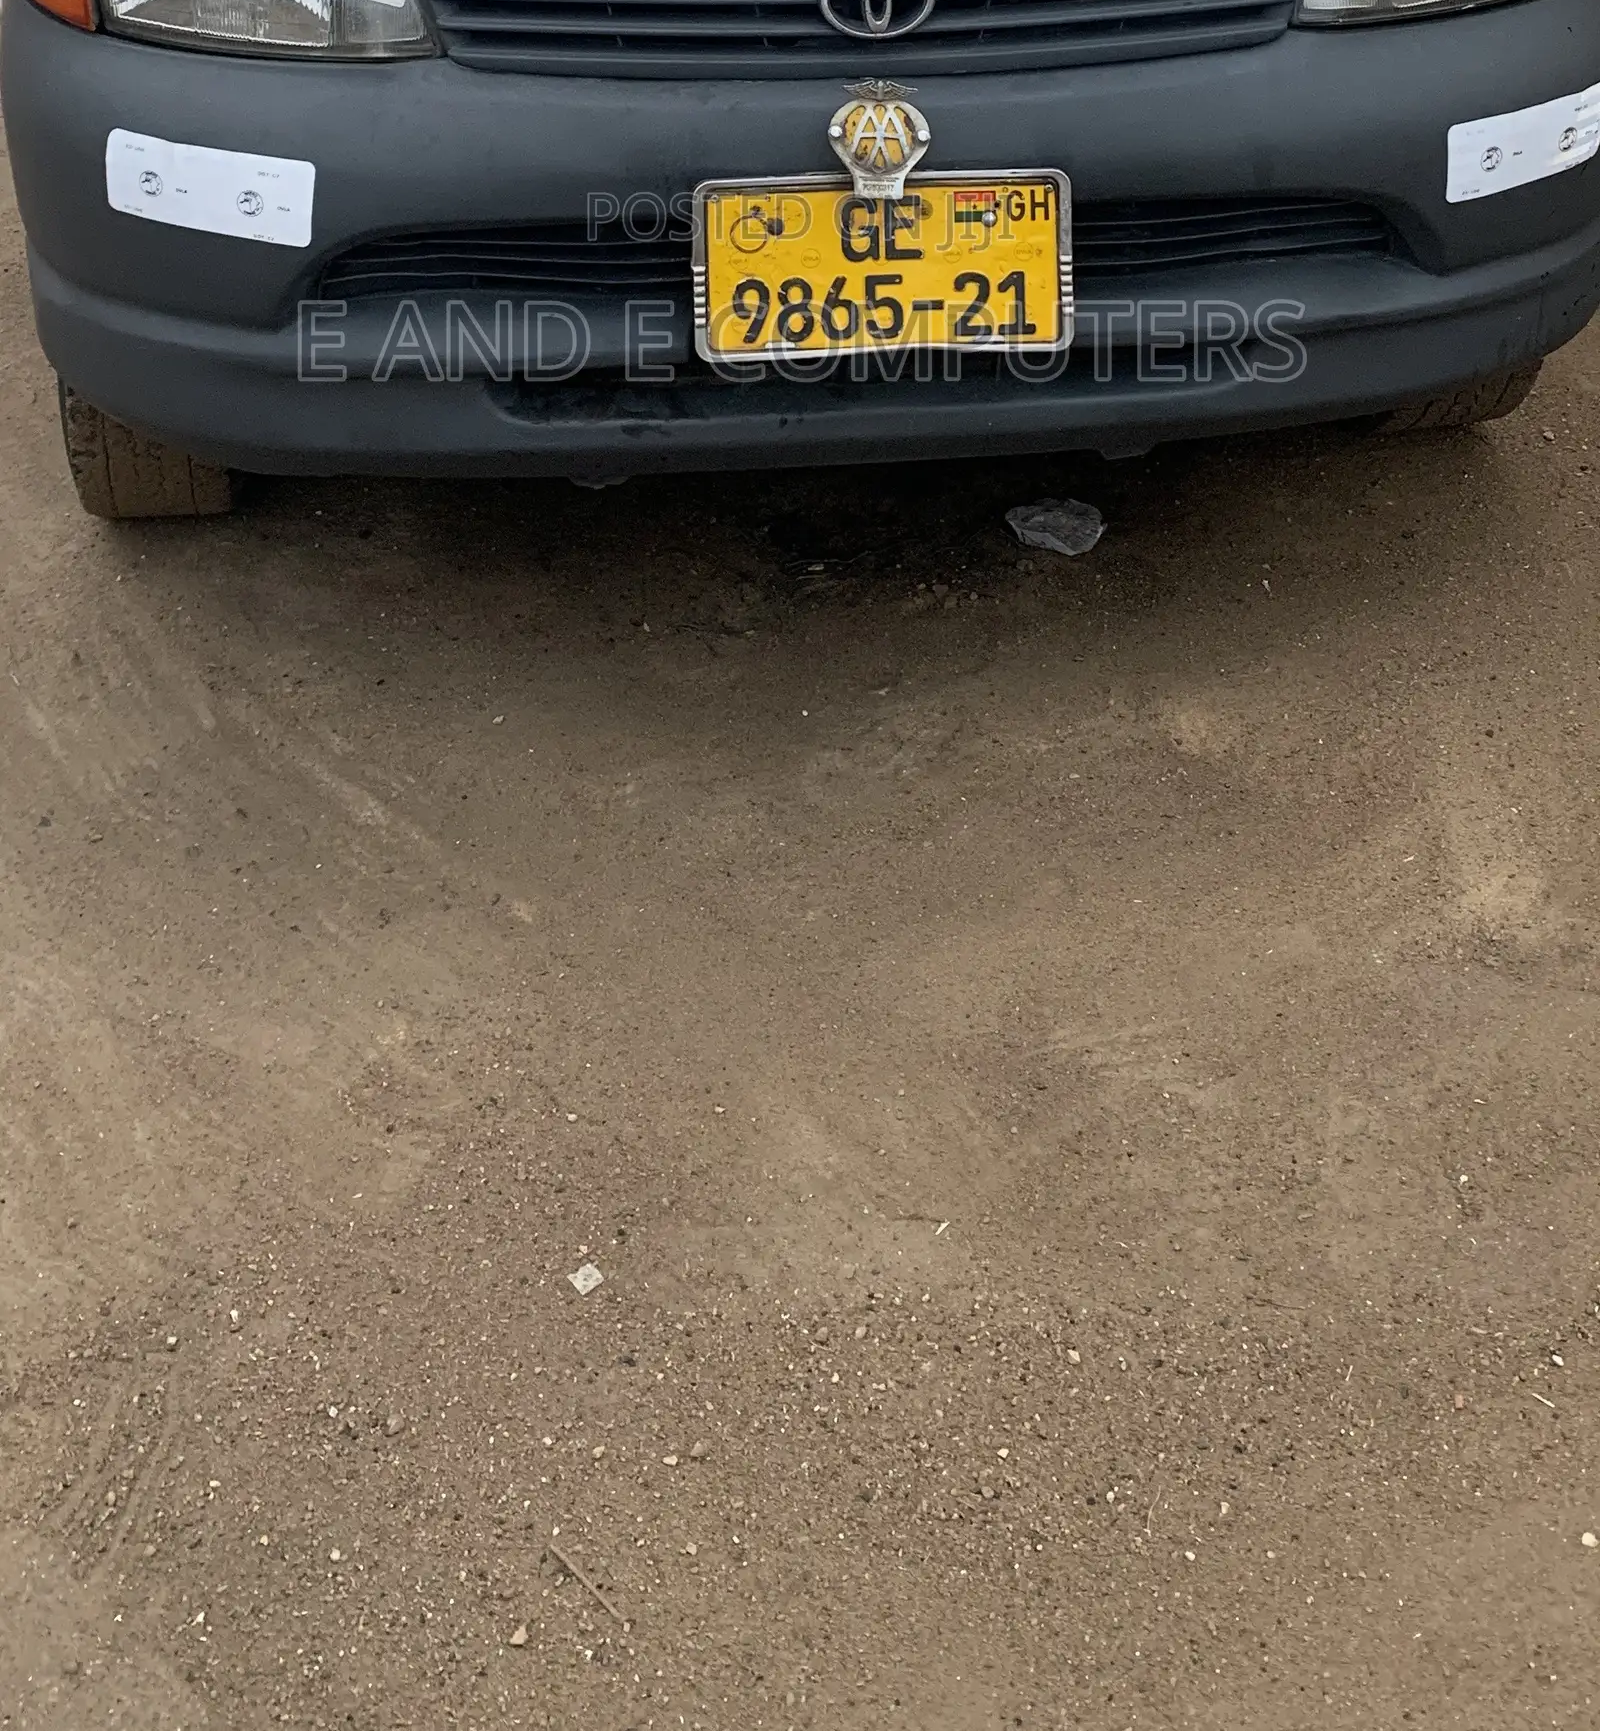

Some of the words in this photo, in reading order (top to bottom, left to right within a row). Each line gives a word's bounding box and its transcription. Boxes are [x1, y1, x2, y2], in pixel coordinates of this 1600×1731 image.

[851, 103, 910, 168] AA
[840, 193, 923, 263] GE
[1007, 189, 1050, 221] GH
[732, 270, 1037, 344] 9865-21
